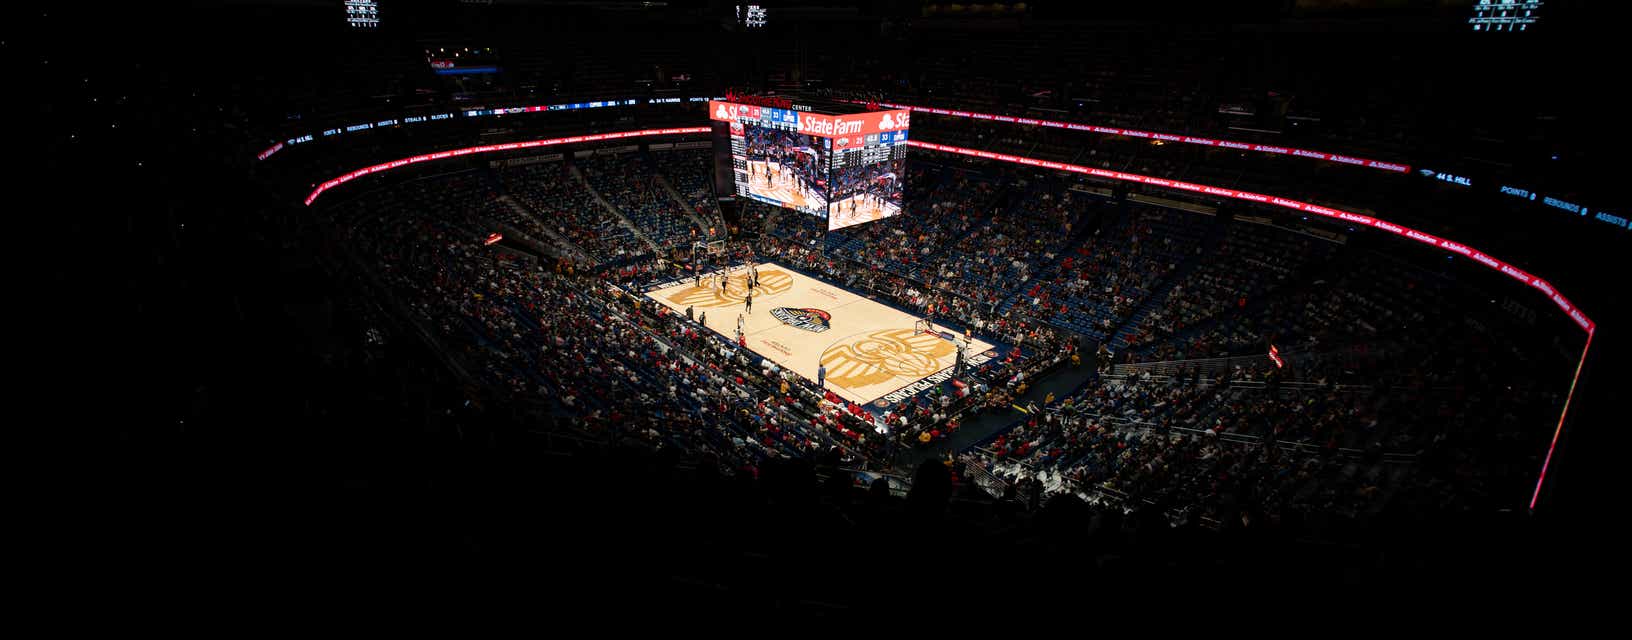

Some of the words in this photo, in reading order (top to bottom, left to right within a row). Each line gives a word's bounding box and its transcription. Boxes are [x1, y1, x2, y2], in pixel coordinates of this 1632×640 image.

[792, 104, 812, 112] CENTER
[1436, 173, 1446, 181] 44
[1454, 176, 1471, 186] HILL
[1501, 185, 1528, 198] POINTS
[1543, 196, 1580, 213] REBOUNDS
[1595, 211, 1628, 227] ASSISTS
